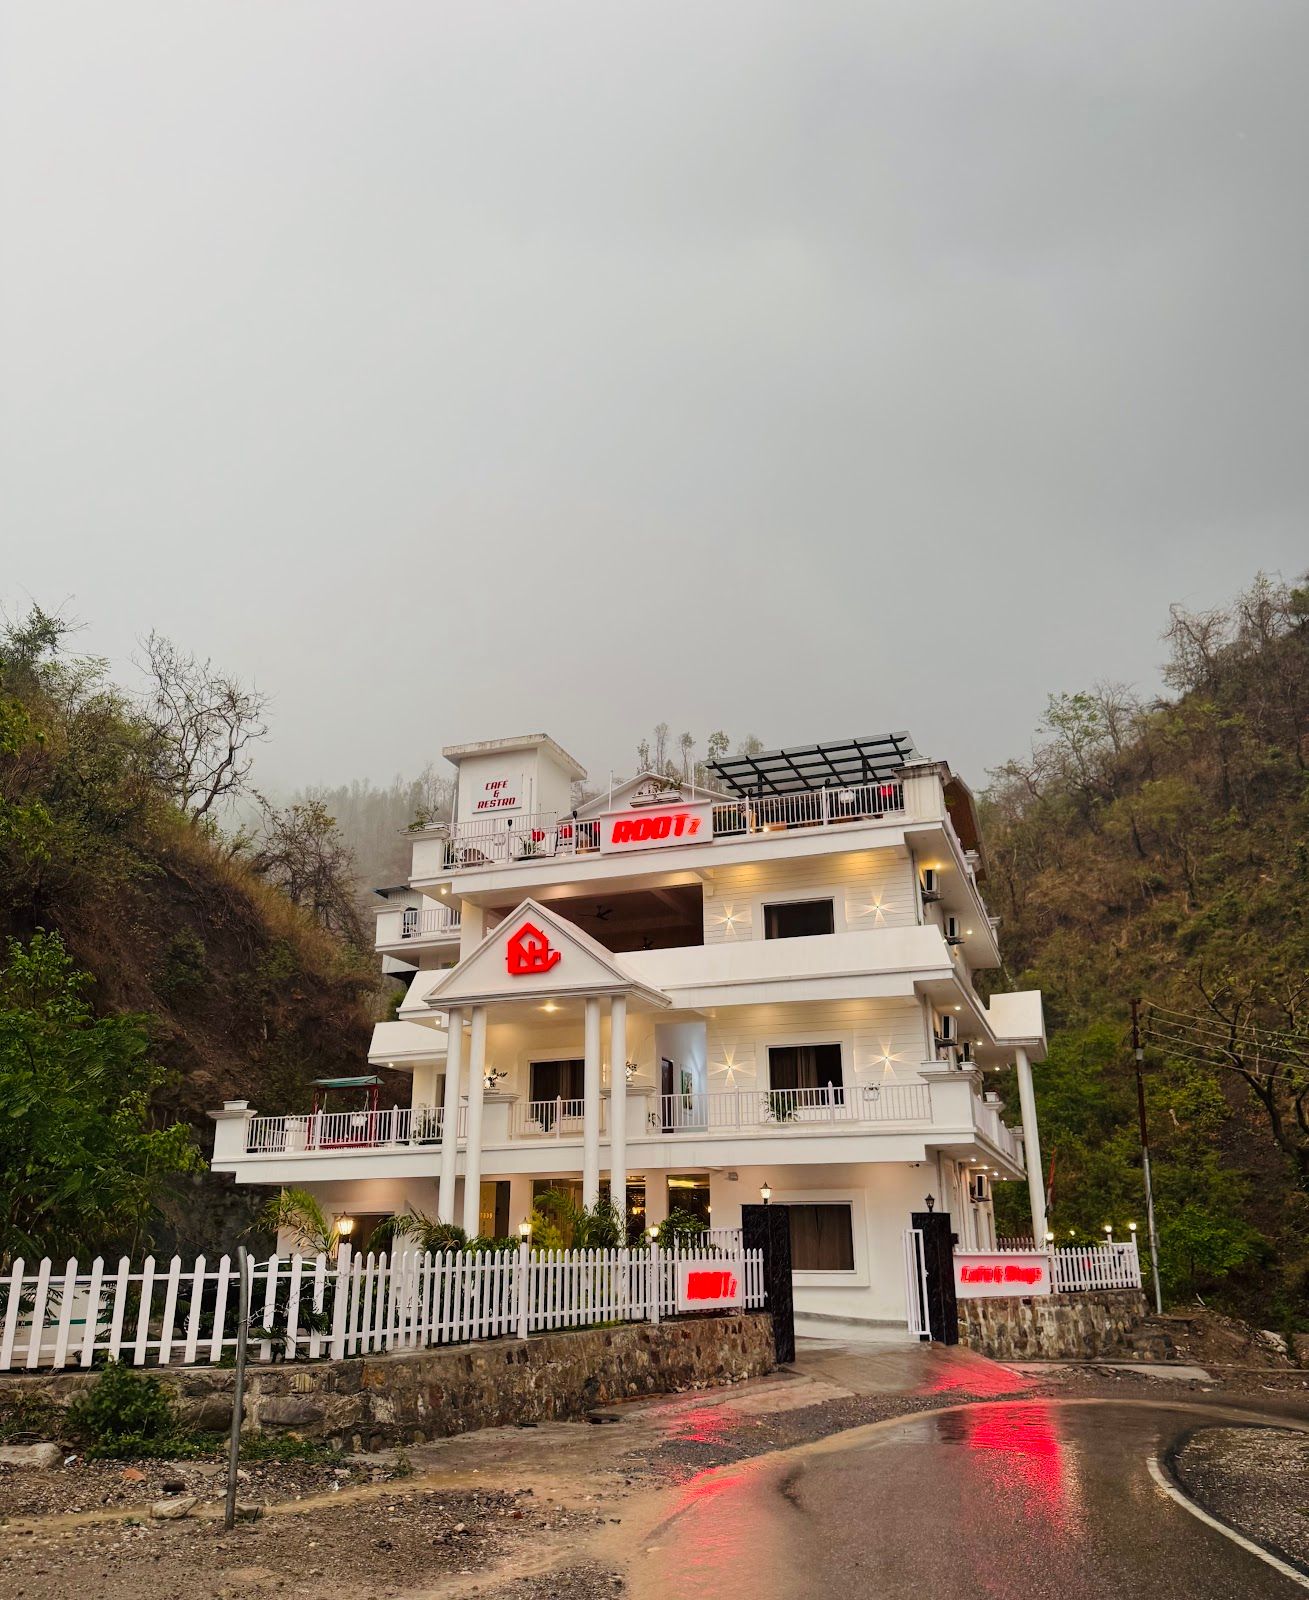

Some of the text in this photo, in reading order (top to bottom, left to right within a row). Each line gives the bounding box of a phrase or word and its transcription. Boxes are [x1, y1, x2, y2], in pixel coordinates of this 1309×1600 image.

[485, 780, 508, 790] CAFE
[493, 790, 499, 798] &
[477, 797, 516, 808] RESTRO
